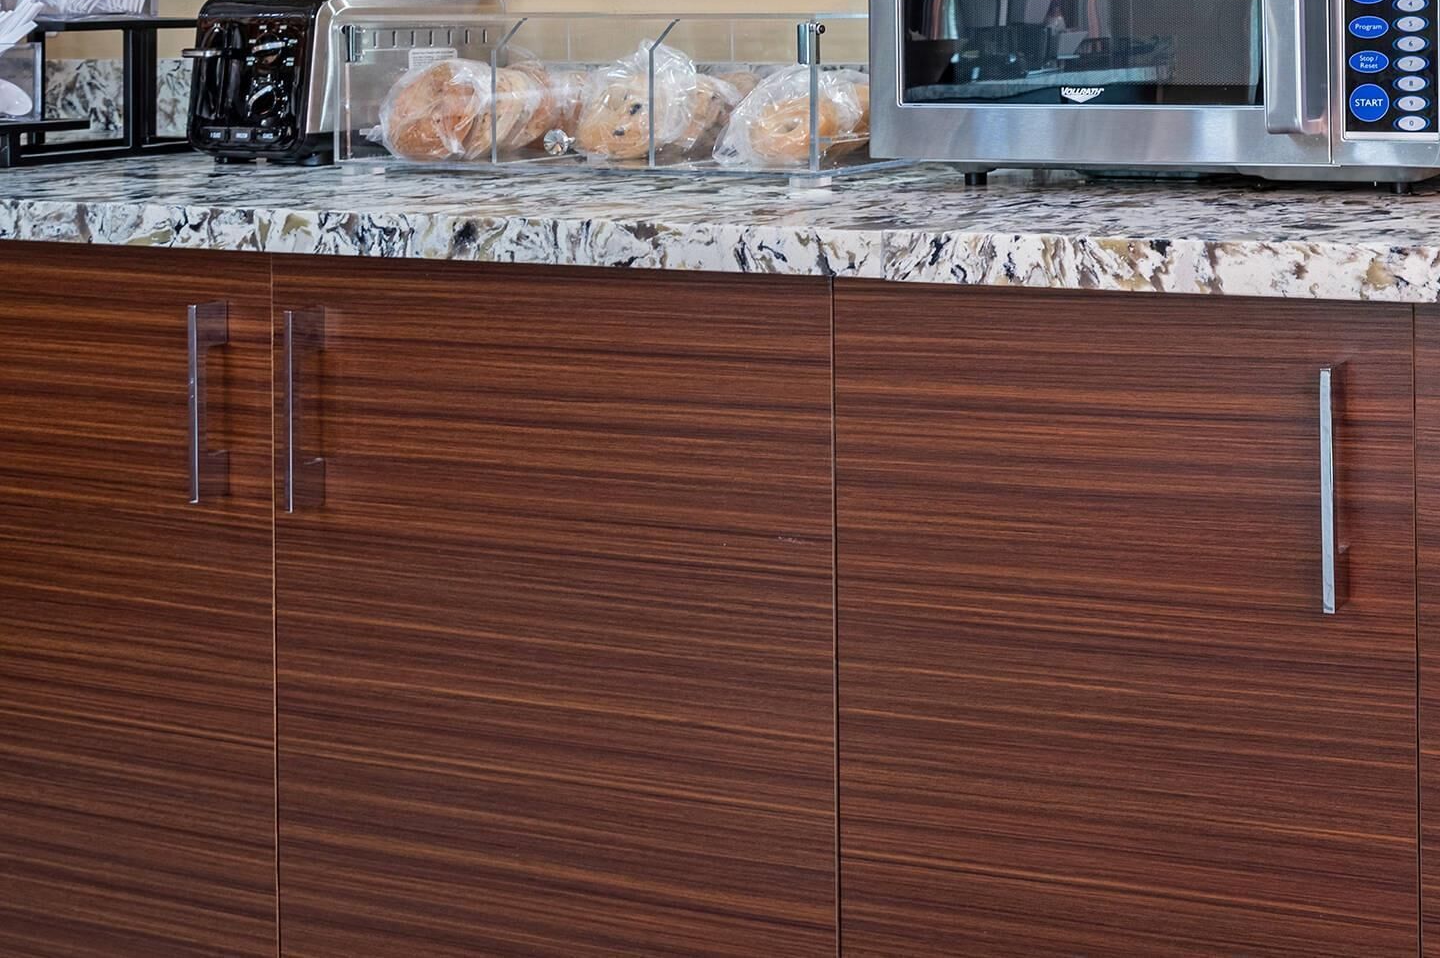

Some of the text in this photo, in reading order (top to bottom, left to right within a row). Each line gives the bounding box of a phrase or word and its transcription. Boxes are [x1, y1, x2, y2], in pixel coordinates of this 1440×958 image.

[1354, 23, 1383, 32] Program
[1061, 87, 1104, 96] VOLLRATH
[1354, 98, 1383, 107] START
